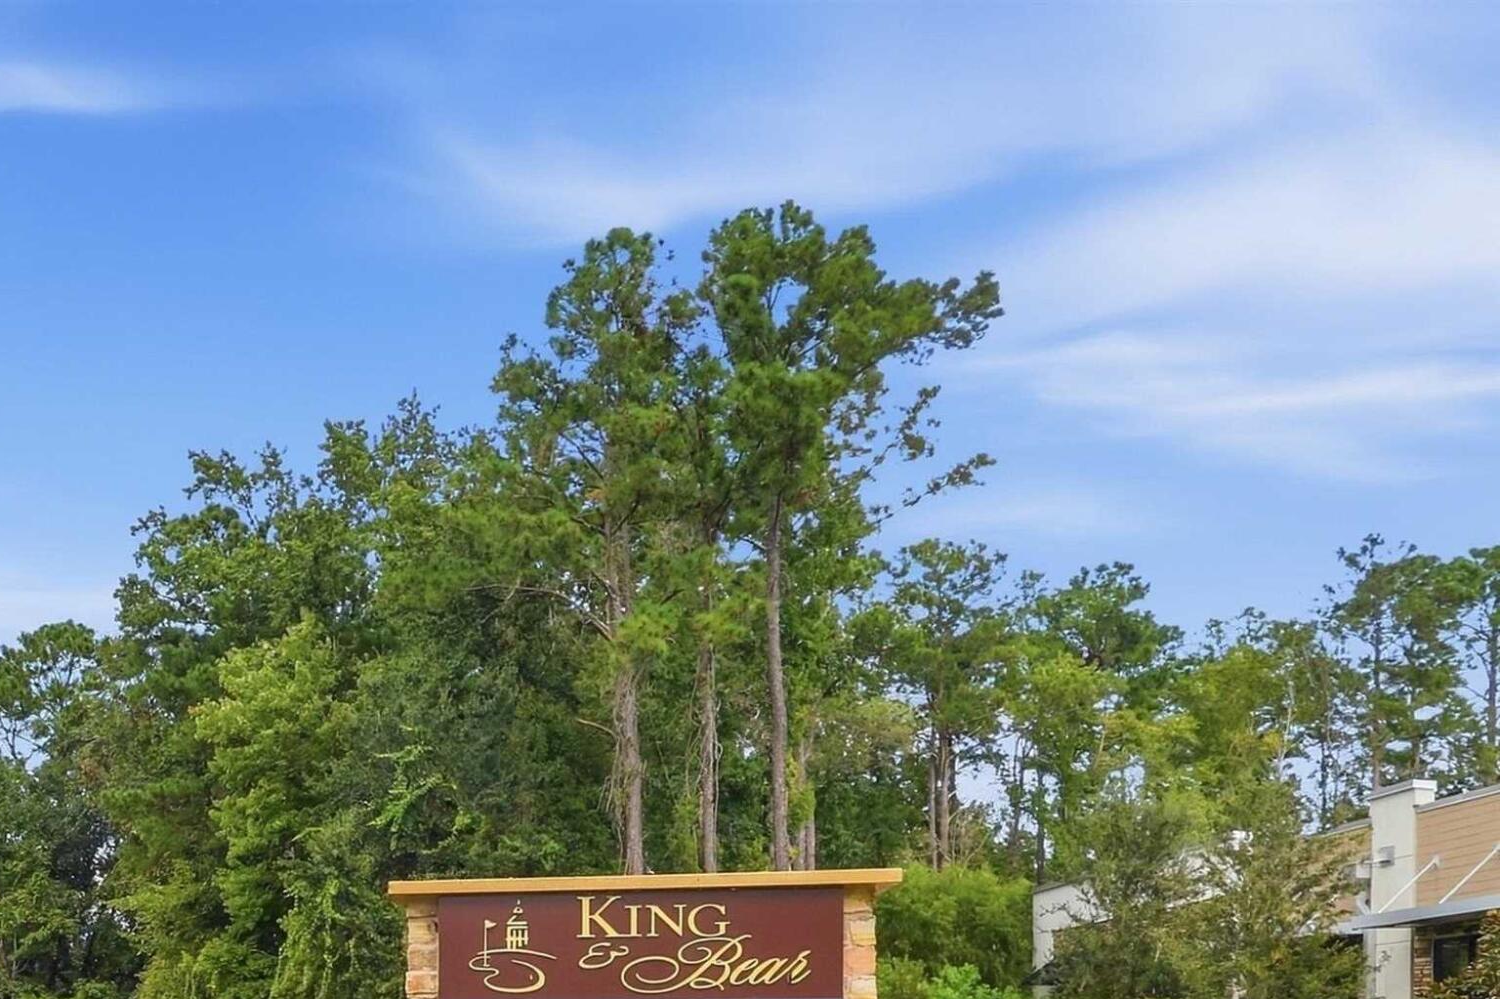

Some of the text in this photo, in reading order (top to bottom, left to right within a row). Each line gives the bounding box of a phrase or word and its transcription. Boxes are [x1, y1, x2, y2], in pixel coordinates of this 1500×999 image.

[576, 895, 730, 938] KING
[578, 934, 812, 994] & Bear
